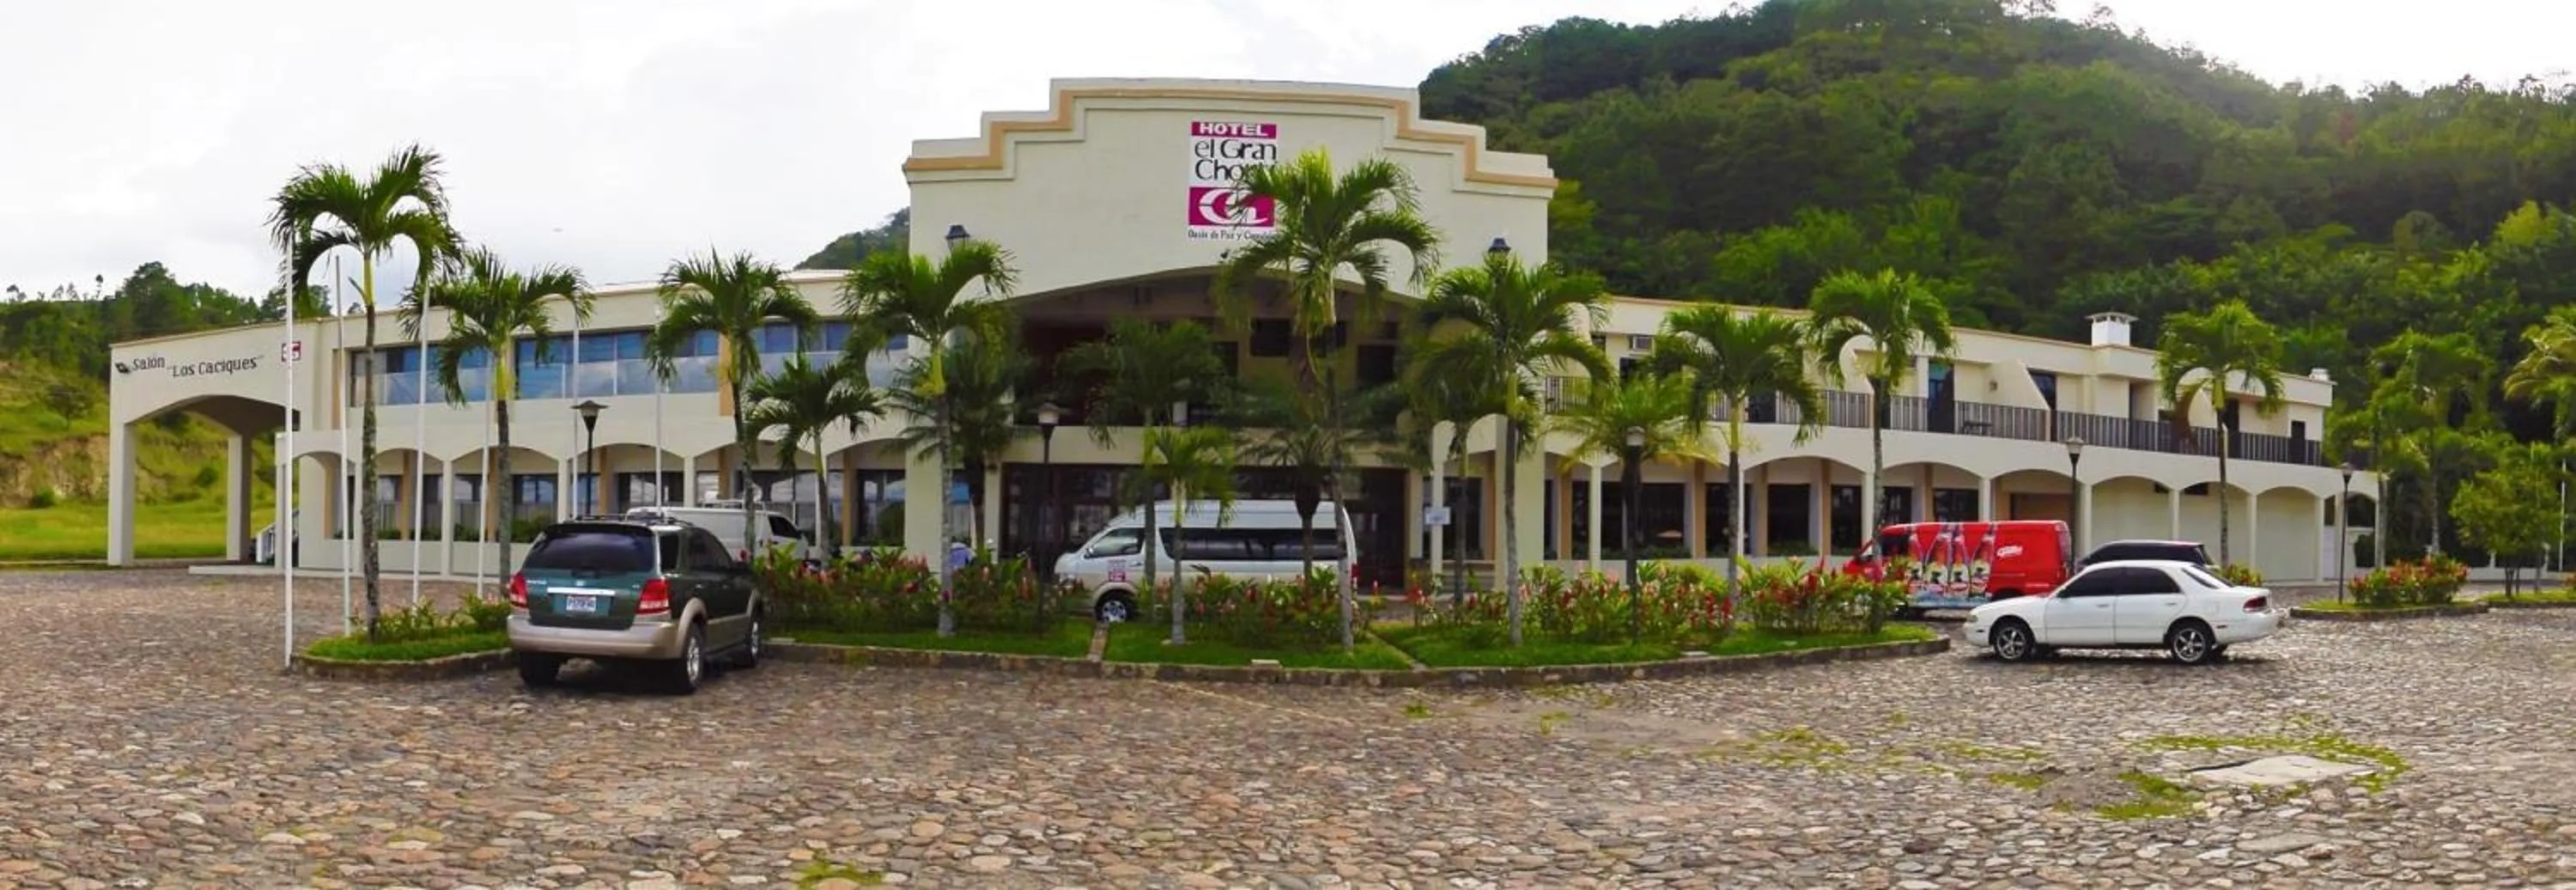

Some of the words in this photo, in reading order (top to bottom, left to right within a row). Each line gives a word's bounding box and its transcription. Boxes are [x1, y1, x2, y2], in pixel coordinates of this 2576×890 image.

[1200, 123, 1268, 137] HOTEL
[1194, 139, 1215, 158] el
[1220, 139, 1277, 161] Gran
